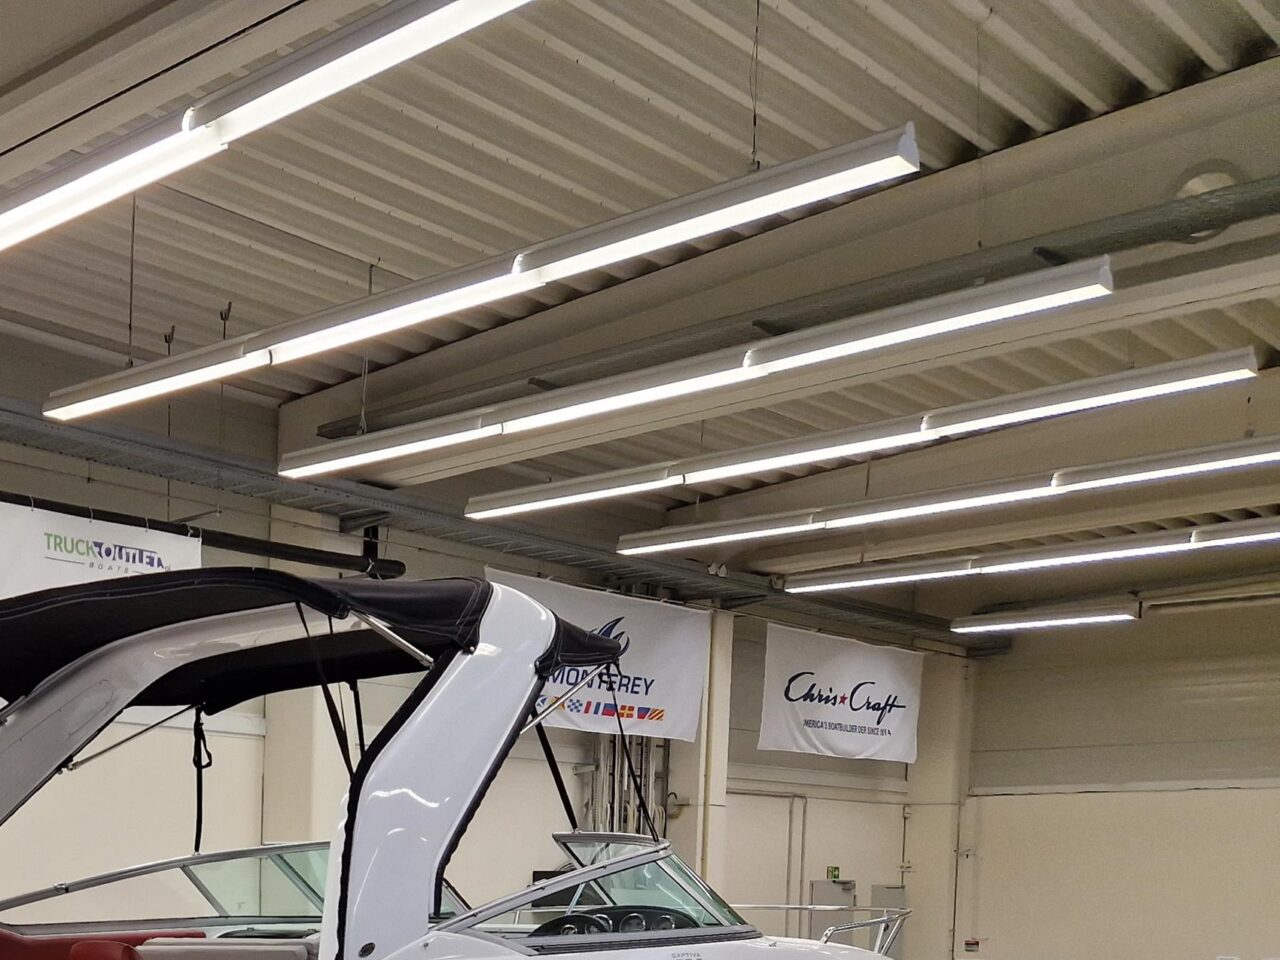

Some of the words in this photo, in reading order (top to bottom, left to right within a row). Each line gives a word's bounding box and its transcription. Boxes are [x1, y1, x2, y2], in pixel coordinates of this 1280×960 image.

[88, 562, 129, 574] BOATS
[784, 671, 838, 706] Chris
[849, 681, 907, 726] Craft
